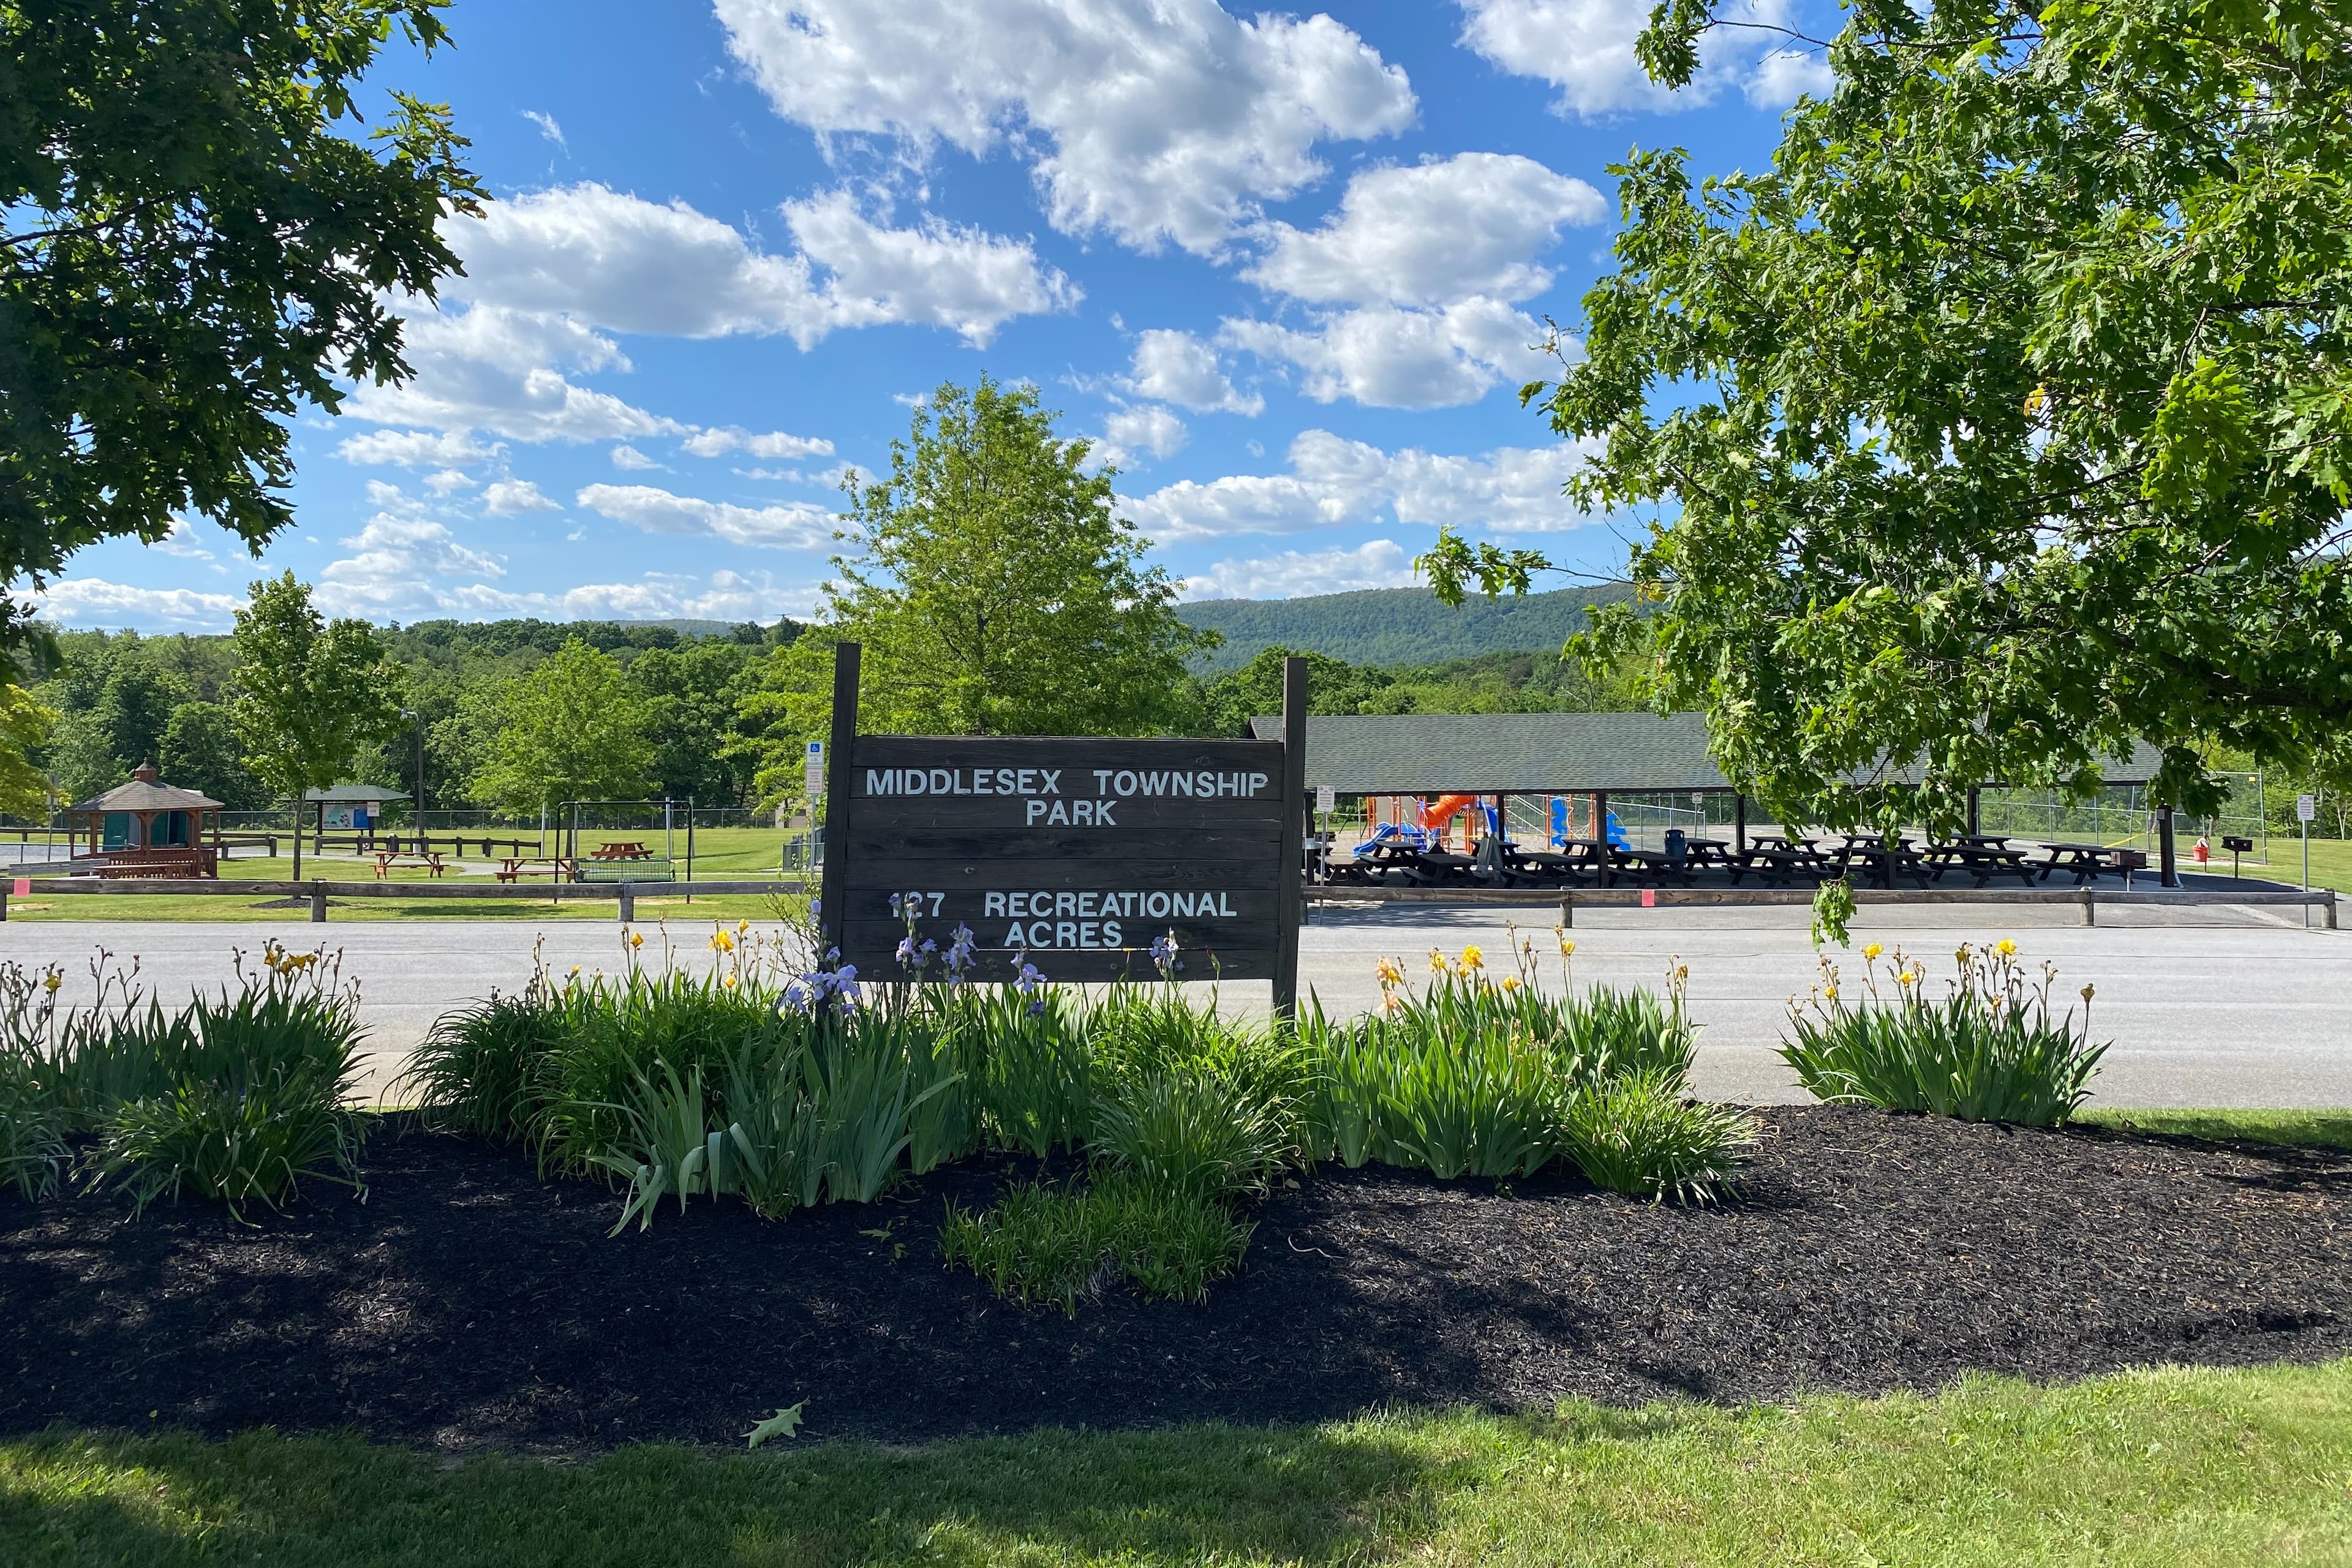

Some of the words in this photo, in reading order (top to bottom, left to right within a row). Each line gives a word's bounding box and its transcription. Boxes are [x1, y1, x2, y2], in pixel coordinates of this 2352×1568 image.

[867, 769, 1061, 795] MIDDLESEX
[1093, 770, 1268, 797] TOWNSHIP
[1027, 799, 1117, 826] PARK
[985, 891, 1237, 918] RECREATIONAL
[1005, 921, 1122, 948] ACRES
